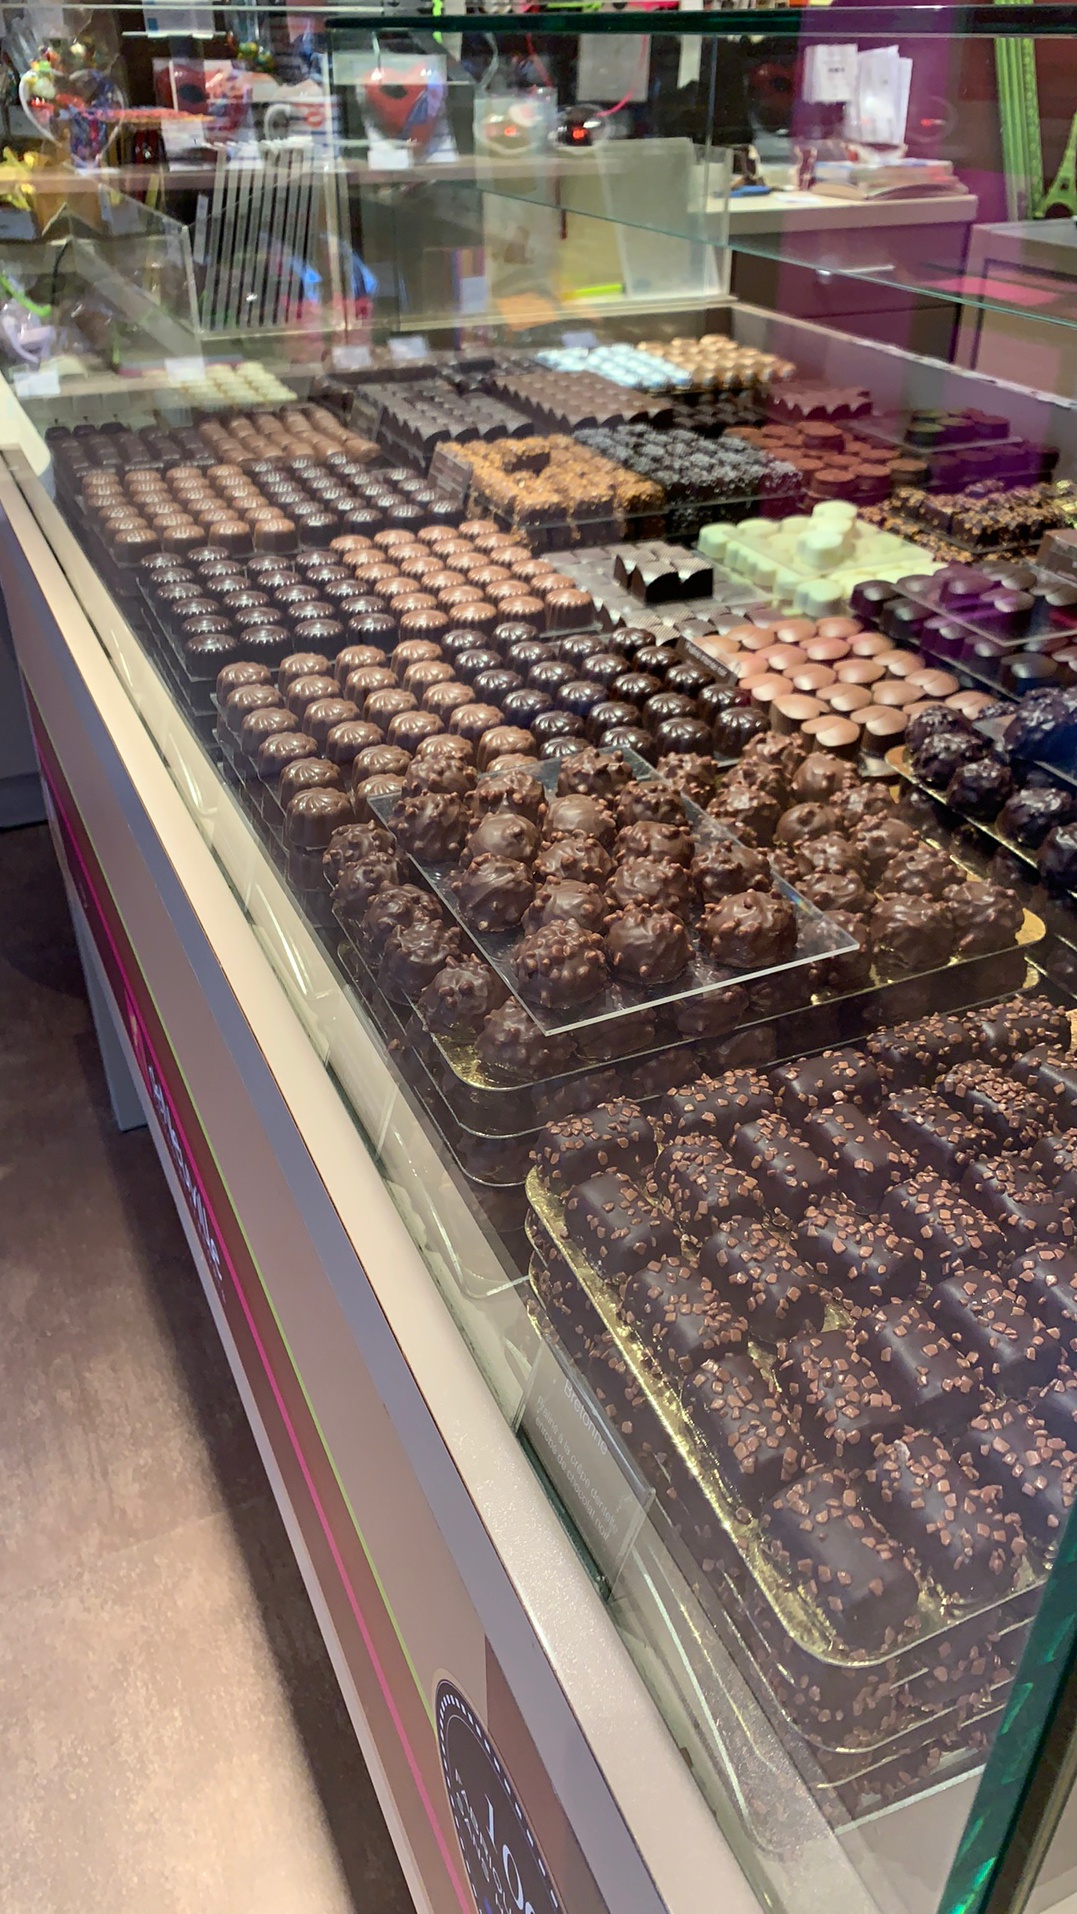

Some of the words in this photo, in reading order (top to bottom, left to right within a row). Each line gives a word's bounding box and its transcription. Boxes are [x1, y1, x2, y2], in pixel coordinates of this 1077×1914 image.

[564, 1379, 608, 1455] Bretonne
[534, 1416, 558, 1455] enrobé
[556, 1453, 567, 1471] de
[566, 1469, 596, 1520] chocolat
[570, 1454, 591, 1488] crêpe
[484, 1793, 536, 1914] 10
